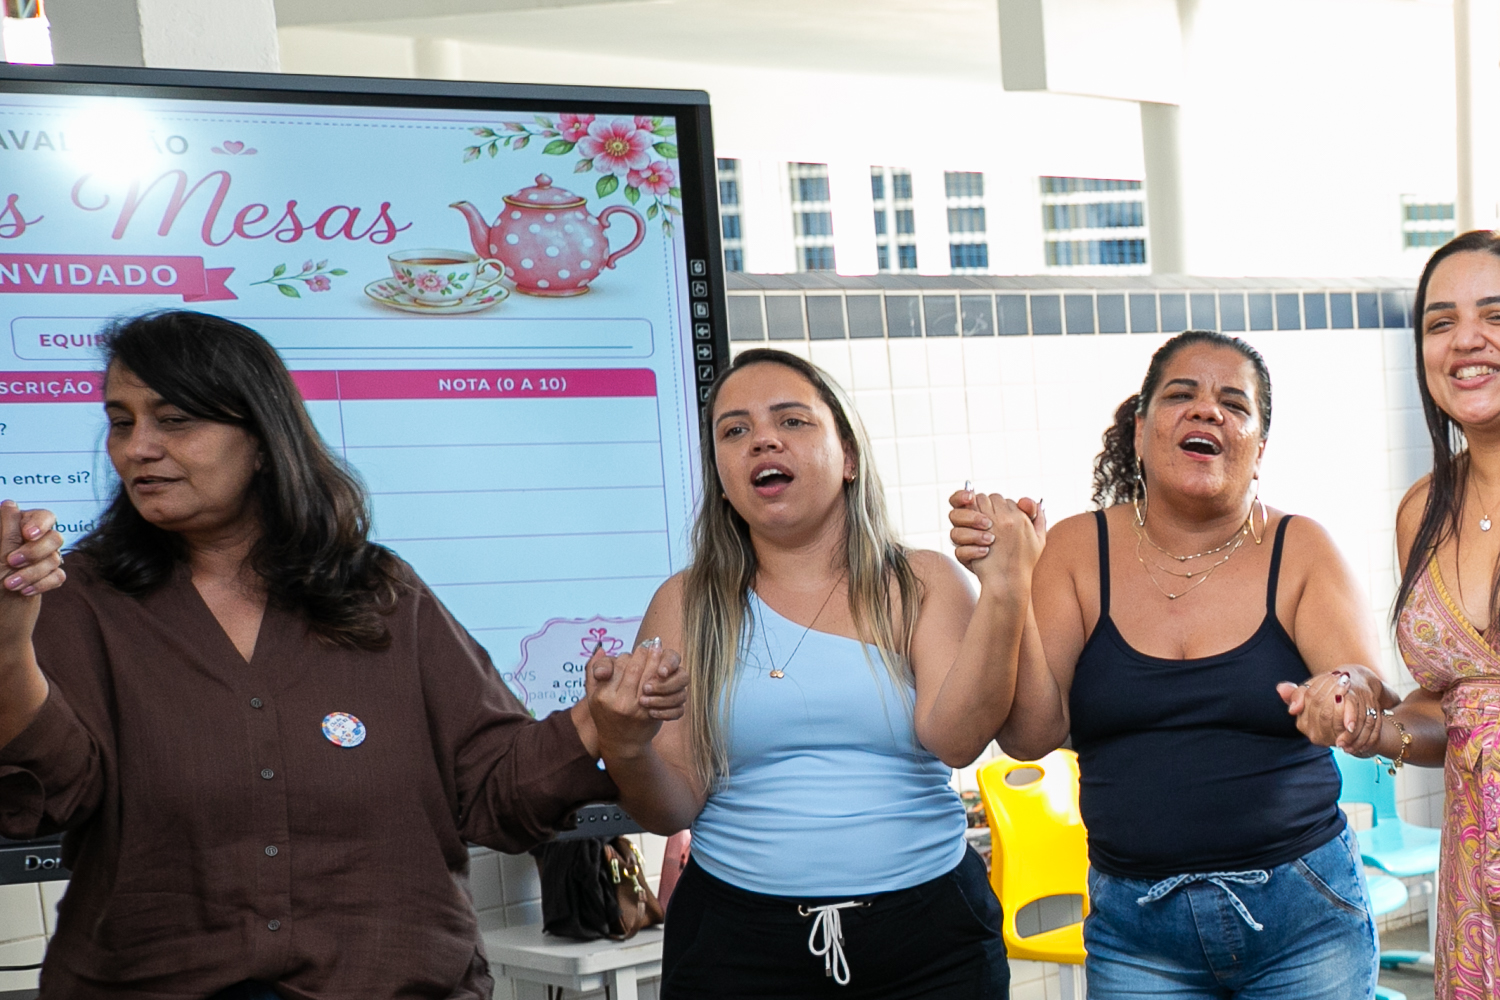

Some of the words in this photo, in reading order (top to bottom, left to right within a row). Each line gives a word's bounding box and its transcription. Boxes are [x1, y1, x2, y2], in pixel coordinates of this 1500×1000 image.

[71, 169, 413, 246] Mesas
[0, 263, 178, 287] NVIDADO
[40, 334, 105, 348] EQUIP
[0, 378, 93, 397] SCRIÇÃO
[438, 378, 490, 391] NOTA
[496, 376, 515, 392] (0
[521, 377, 533, 390] A
[539, 376, 567, 391] 10)
[13, 473, 62, 485] entre
[67, 471, 90, 484] si?
[563, 661, 585, 673] Qu
[560, 688, 583, 699] ativ
